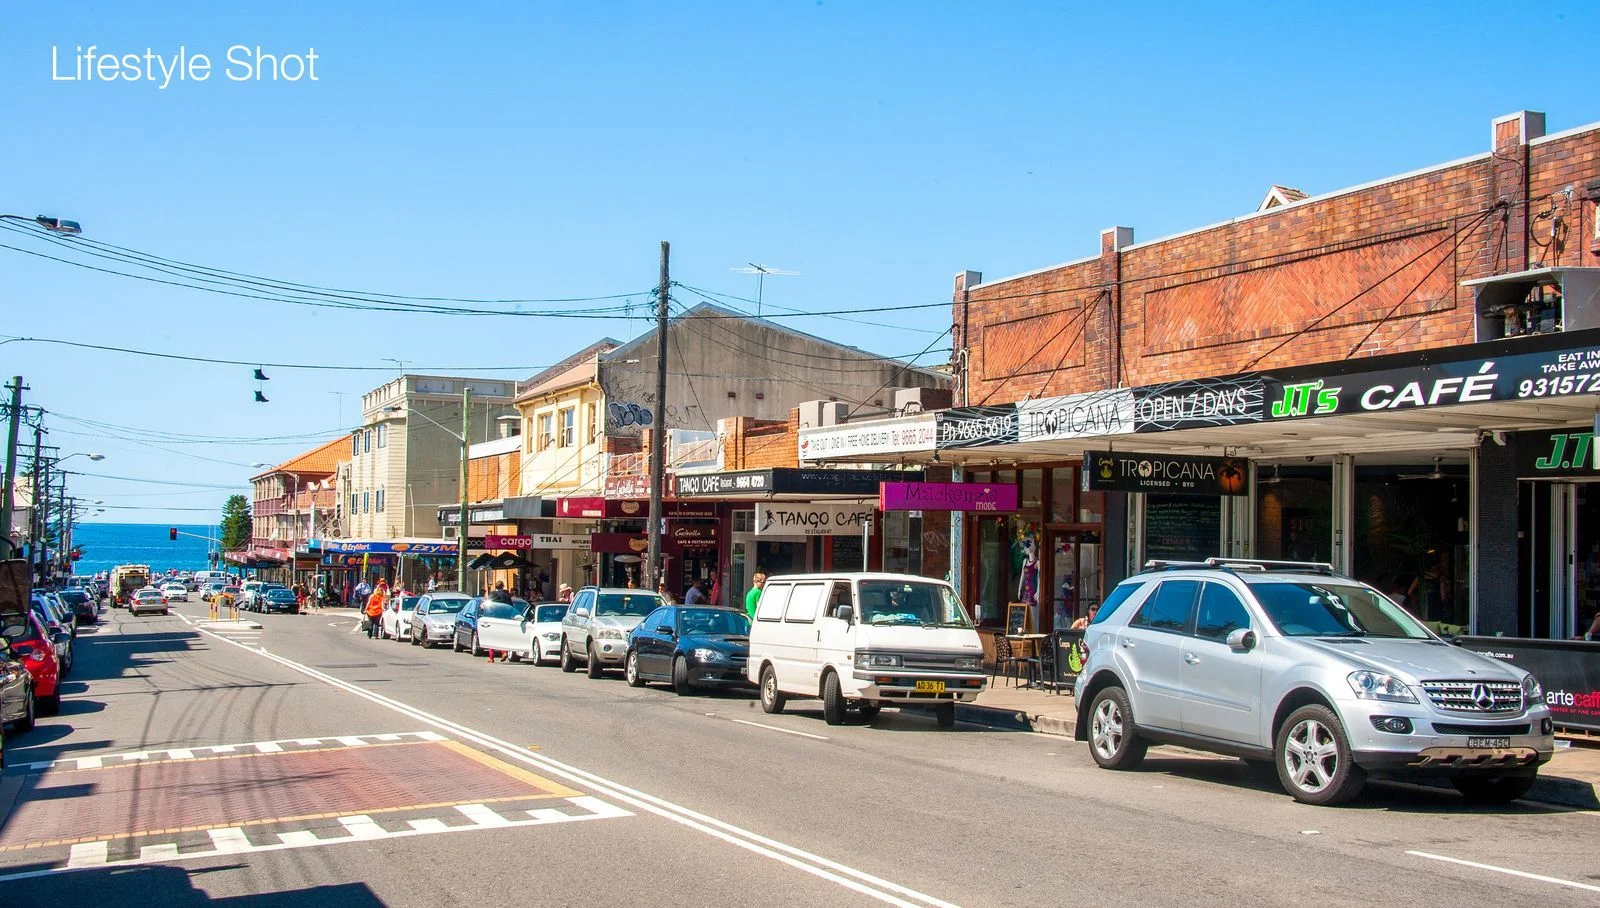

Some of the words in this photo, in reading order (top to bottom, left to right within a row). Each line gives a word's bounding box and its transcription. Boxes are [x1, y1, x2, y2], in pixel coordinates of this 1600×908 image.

[1559, 352, 1584, 363] EAT
[1587, 350, 1600, 360] IN
[1541, 363, 1576, 373] TAKE
[1361, 361, 1498, 410] CAFÉ
[1518, 373, 1600, 397] 931572
[1140, 396, 1185, 422] OPEN
[1189, 394, 1204, 418] 7
[1204, 388, 1246, 417] DAYS
[1028, 402, 1121, 436] TROPICANA
[1119, 459, 1216, 480] TROPICANA
[680, 477, 700, 495] TANGO
[702, 476, 720, 493] CAFE
[776, 511, 830, 528] TANGO
[501, 537, 532, 548] cargo
